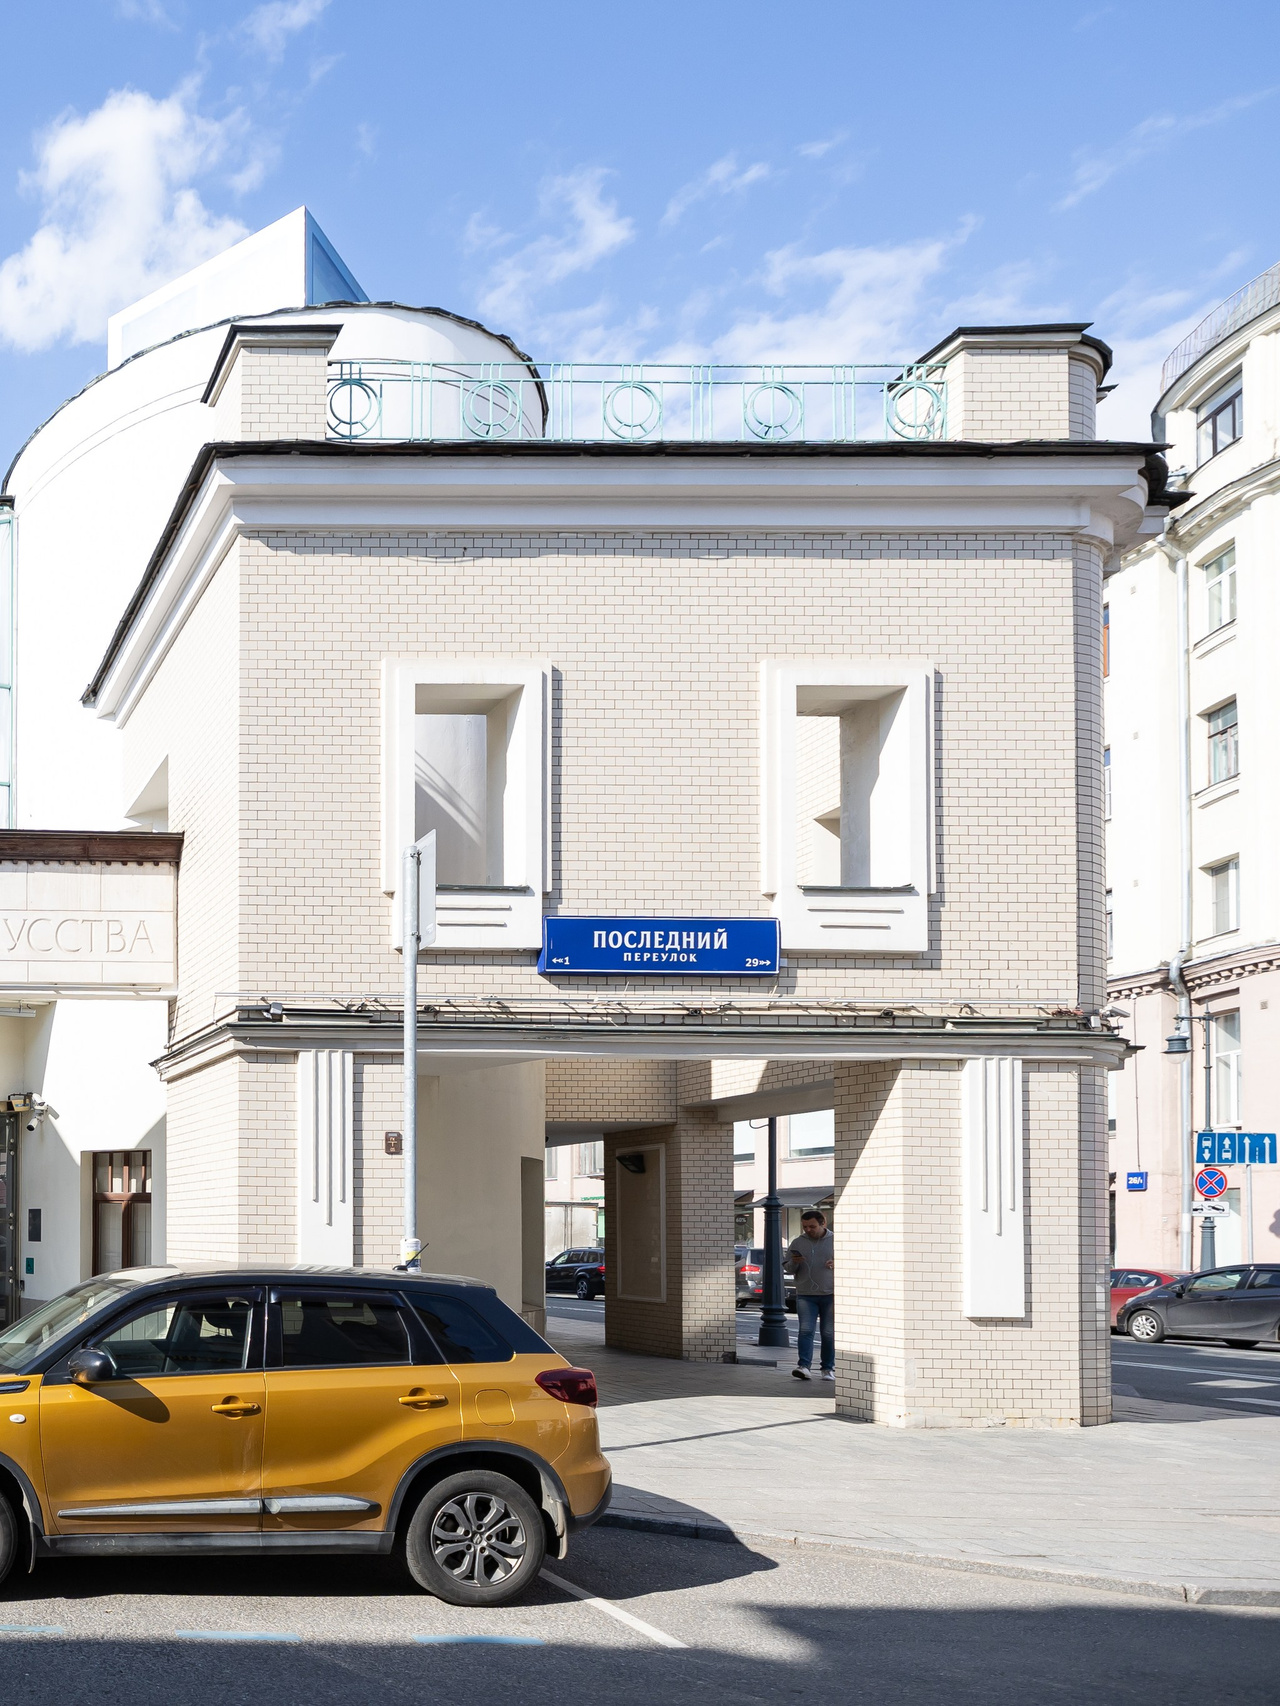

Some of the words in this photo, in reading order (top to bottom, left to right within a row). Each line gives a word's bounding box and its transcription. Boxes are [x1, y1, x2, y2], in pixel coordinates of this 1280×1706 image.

[593, 928, 728, 951] ПОСЛЕДНИЙ
[623, 952, 698, 963] ПЕРЕУЛОК
[745, 958, 759, 967] 29
